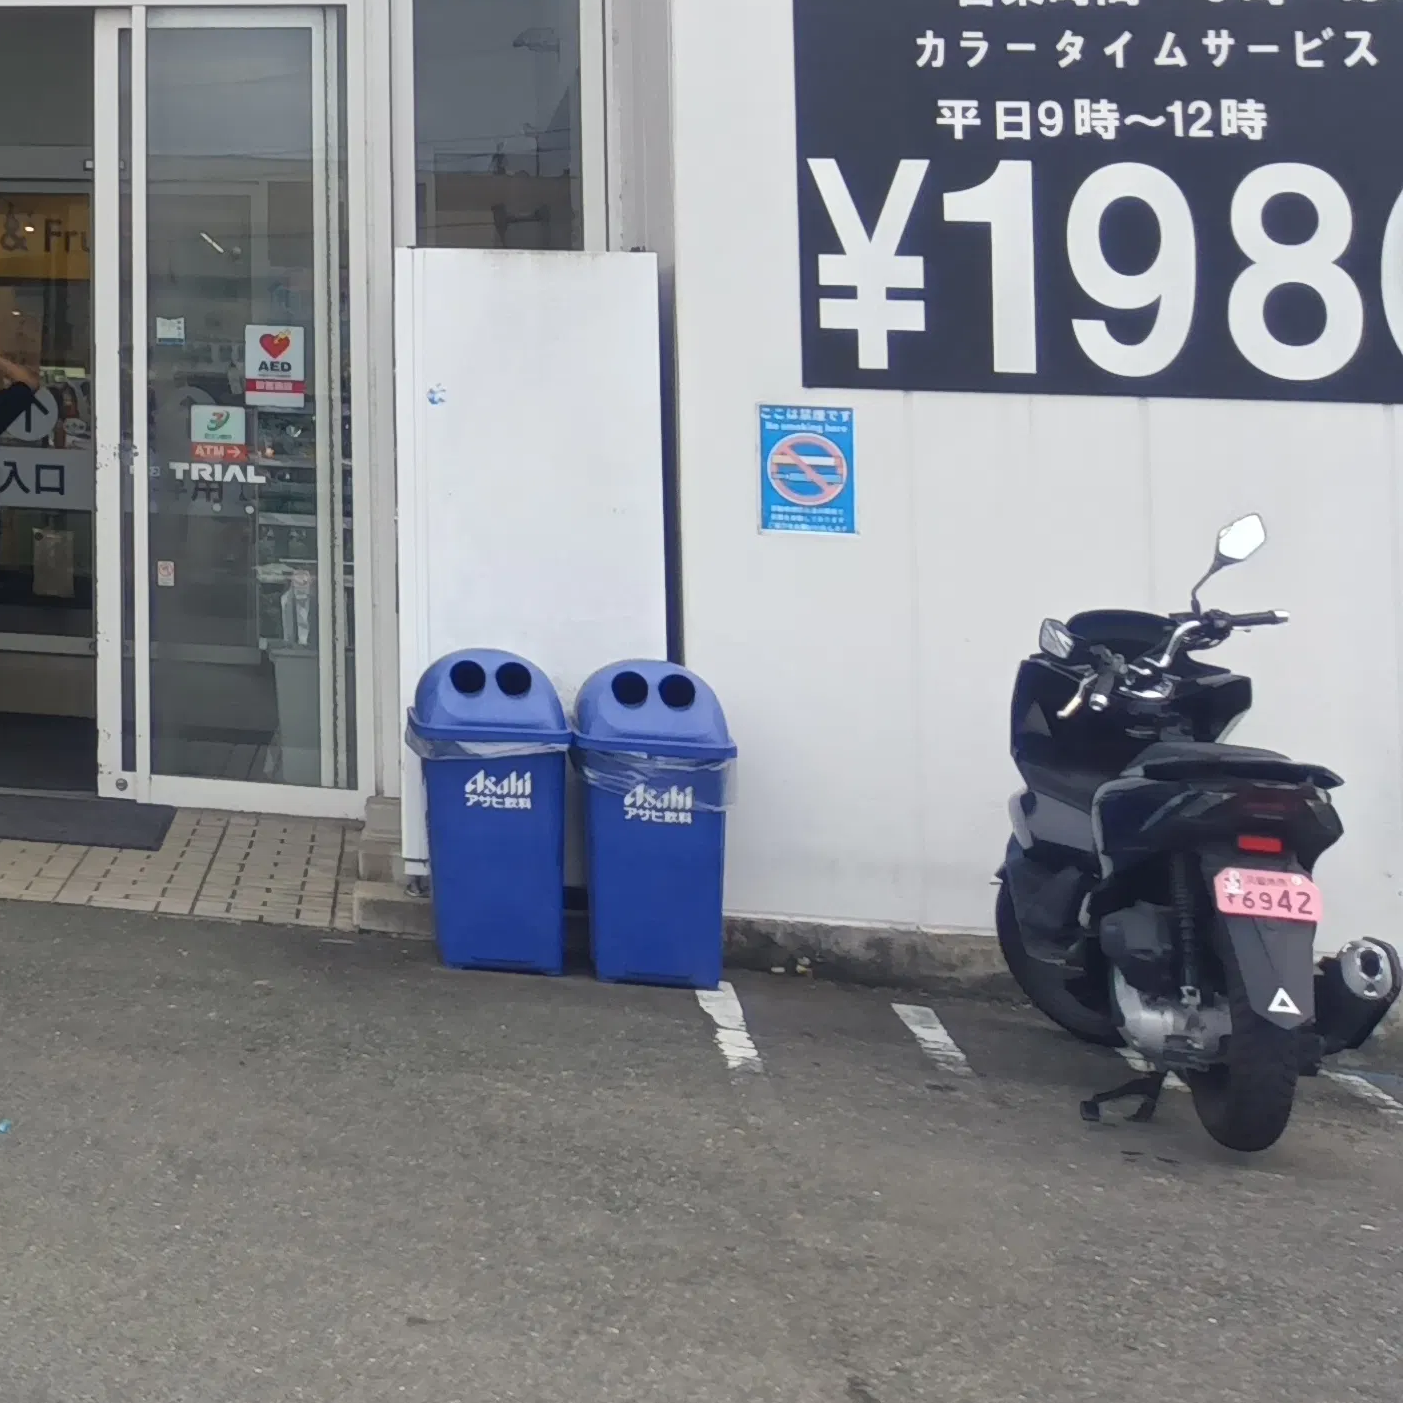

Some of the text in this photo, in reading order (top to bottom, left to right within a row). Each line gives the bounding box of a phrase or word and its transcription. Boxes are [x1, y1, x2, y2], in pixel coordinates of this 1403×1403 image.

[915, 27, 1379, 69] カラータイムサービス
[936, 99, 1268, 141] 平日9時～12時
[807, 158, 1403, 381] ¥198
[258, 361, 292, 373] AED
[194, 444, 225, 458] ATM
[168, 462, 266, 484] TRIAL
[465, 769, 532, 796] Asahi
[623, 783, 693, 810] Asahi
[1242, 889, 1313, 915] 6942
